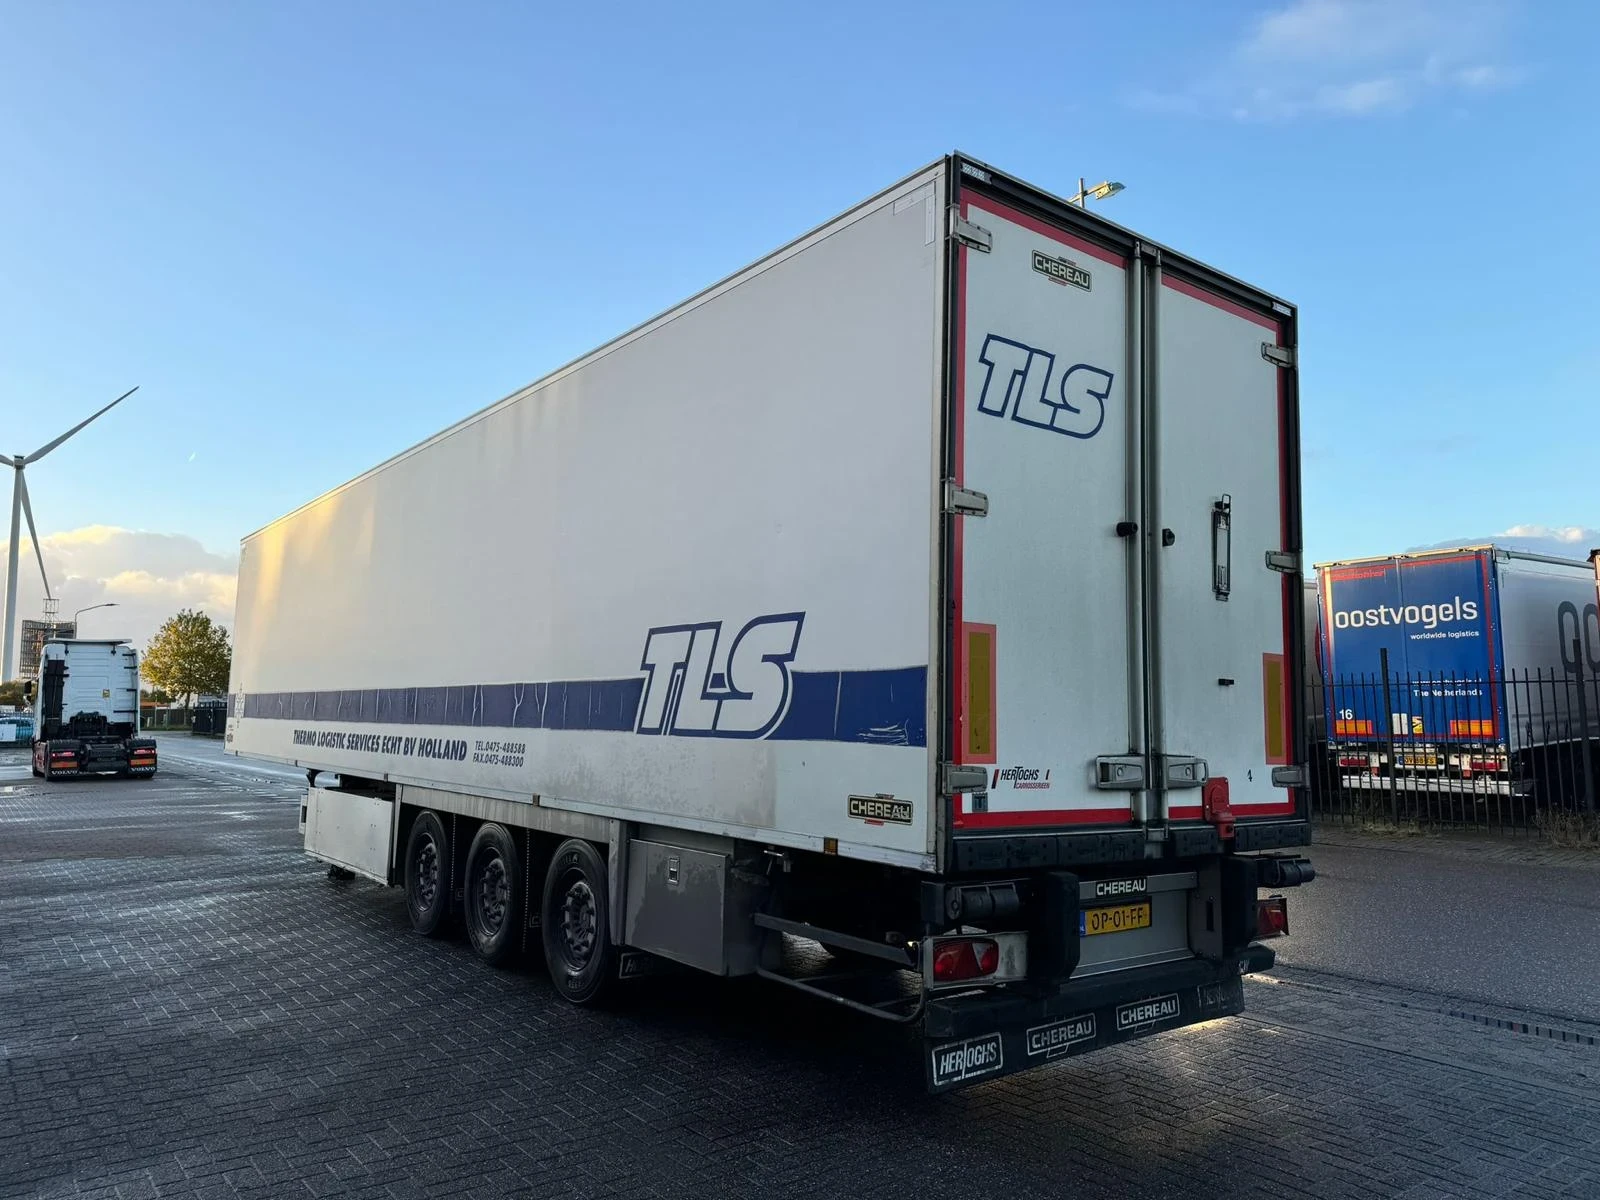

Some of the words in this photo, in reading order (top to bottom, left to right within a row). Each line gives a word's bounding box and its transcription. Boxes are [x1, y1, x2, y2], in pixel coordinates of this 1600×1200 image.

[1035, 255, 1089, 287] CHEREAU
[977, 333, 1114, 439] TLS
[1335, 596, 1479, 629] oostvogels
[1411, 632, 1447, 641] worldwide
[1448, 630, 1480, 640] logistics
[637, 611, 806, 739] TLS
[1339, 708, 1354, 720] 16
[293, 729, 317, 746] THERMO
[317, 731, 347, 749] LOGISTIC
[346, 733, 381, 752] SERVICES
[381, 735, 403, 754] ECHT
[403, 737, 418, 756] BV
[418, 738, 468, 762] HOLLAND
[850, 800, 910, 820] CHEREAU
[1096, 878, 1146, 896] CHEREAU
[1092, 907, 1143, 931] OP-01-FF
[1119, 999, 1176, 1025] CHEREAU
[1031, 1020, 1092, 1049] CHEREAU
